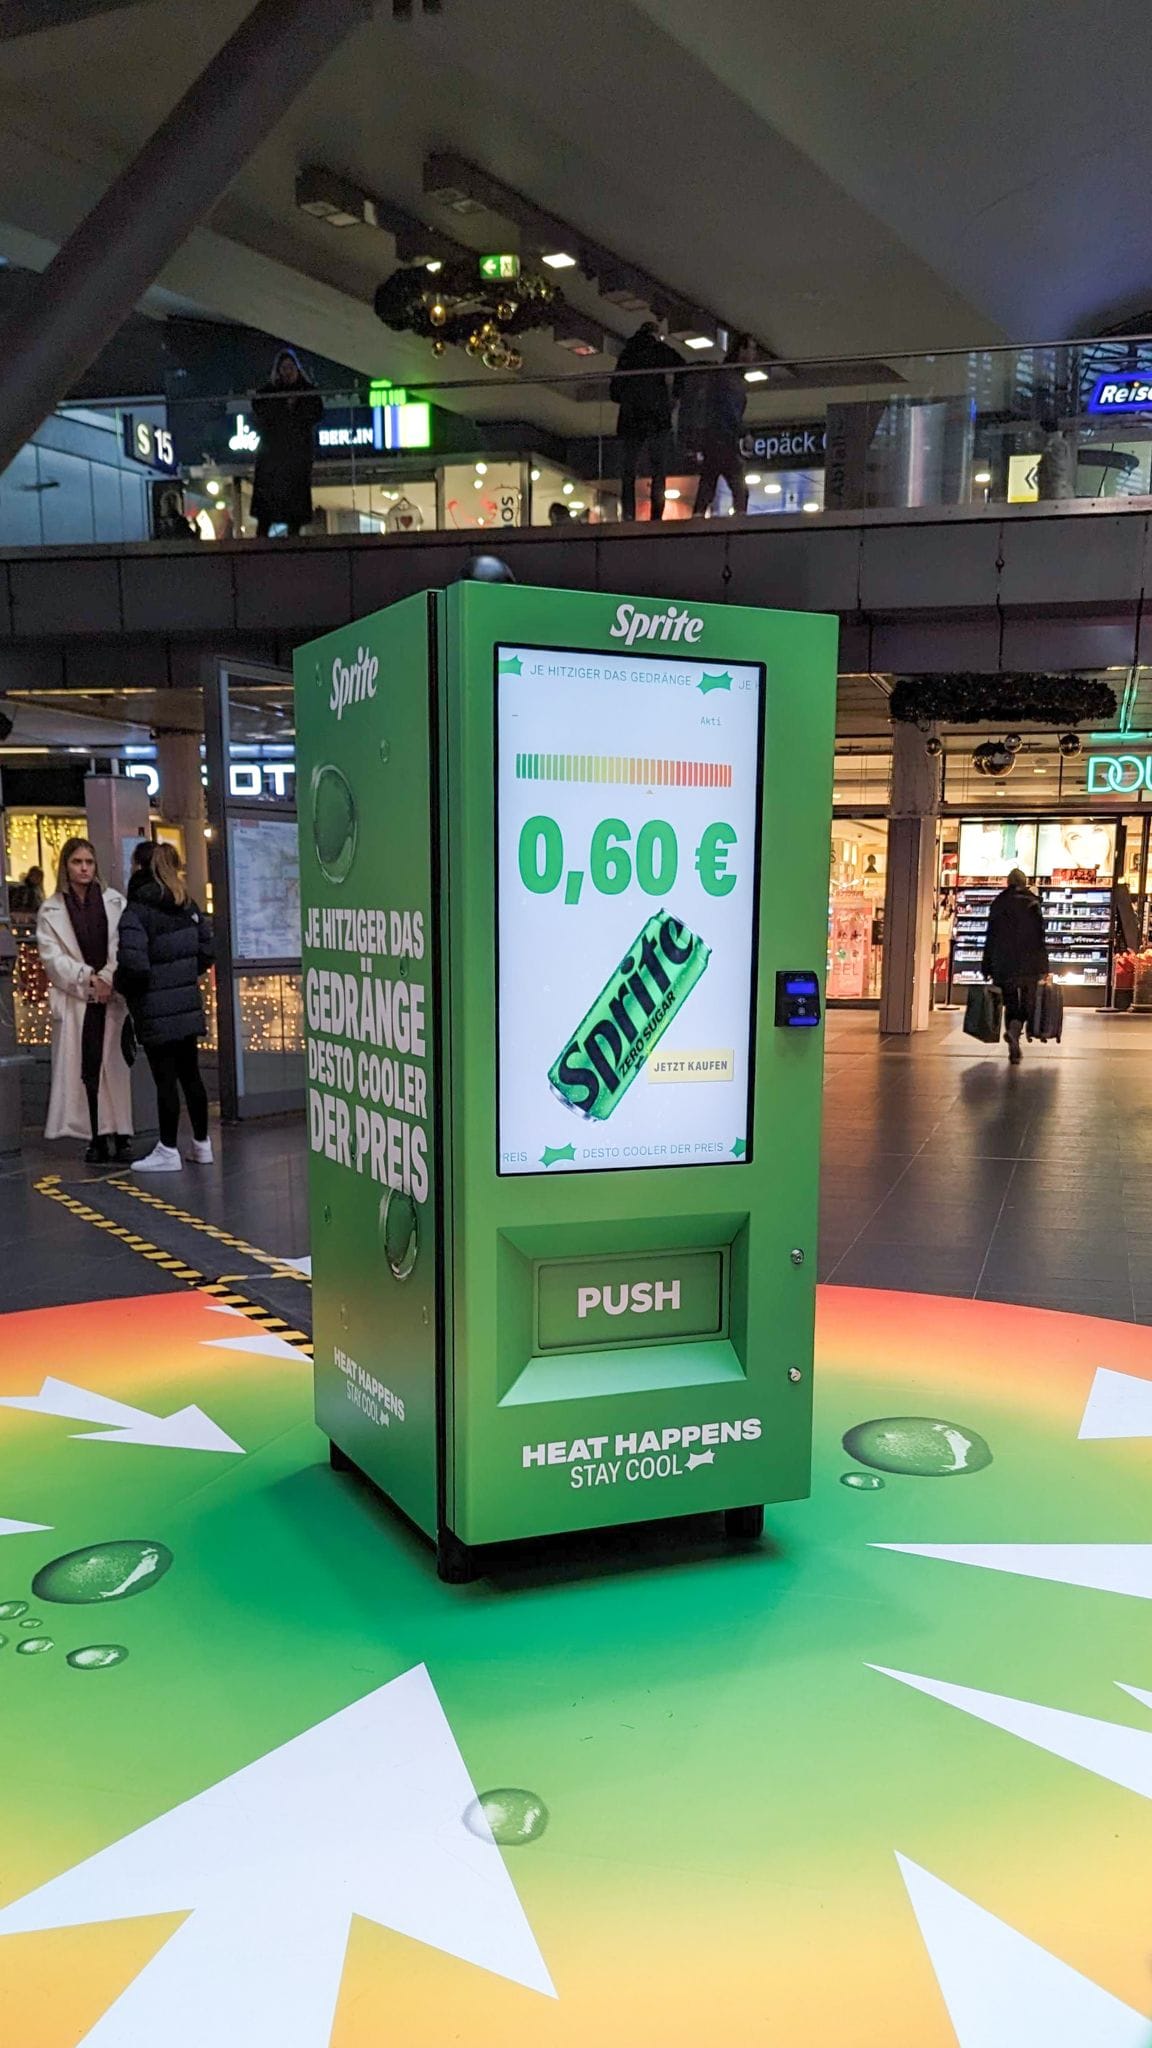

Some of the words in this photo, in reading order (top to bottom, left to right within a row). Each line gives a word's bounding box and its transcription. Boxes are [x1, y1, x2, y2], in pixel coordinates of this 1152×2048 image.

[136, 423, 151, 456] S
[154, 429, 174, 466] 15
[609, 603, 704, 646] Sprite
[329, 645, 378, 721] Sprite
[529, 664, 545, 676] JE
[548, 666, 600, 680] HITZIGER
[604, 670, 627, 682] DAS
[630, 670, 692, 686] GEDRÄNGE
[738, 680, 752, 691] JE
[700, 716, 722, 727] Akti
[125, 763, 295, 797] DOT
[1088, 755, 1152, 793] DO
[518, 815, 679, 905] 0,60
[694, 821, 738, 897] €
[305, 907, 323, 948] JE
[322, 909, 388, 955] HITZIGER
[390, 909, 425, 961] DAS
[305, 957, 427, 1058] GEDRÄNGE
[557, 916, 694, 1112] Sprite
[619, 1039, 645, 1078] ZERO
[642, 991, 677, 1039] SUGAR
[307, 1042, 355, 1095] DESTO
[357, 1054, 428, 1120] COOLER
[653, 1061, 685, 1073] JETZT
[688, 1059, 728, 1071] KAUFEN
[309, 1087, 352, 1159] DER
[355, 1107, 429, 1202] PREIS
[583, 1147, 620, 1159] DESTO
[622, 1145, 667, 1157] COOLER
[670, 1143, 691, 1155] DER
[694, 1142, 724, 1153] PREIS
[577, 1280, 681, 1319] PUSH
[333, 1346, 358, 1381] HEAT
[358, 1366, 405, 1422] HAPPENS
[346, 1380, 362, 1407] STAY
[361, 1394, 380, 1425] COOL
[522, 1436, 609, 1468] HEAT
[615, 1418, 763, 1457] HAPPENS
[570, 1461, 621, 1489] STAY
[625, 1454, 683, 1482] COOL
